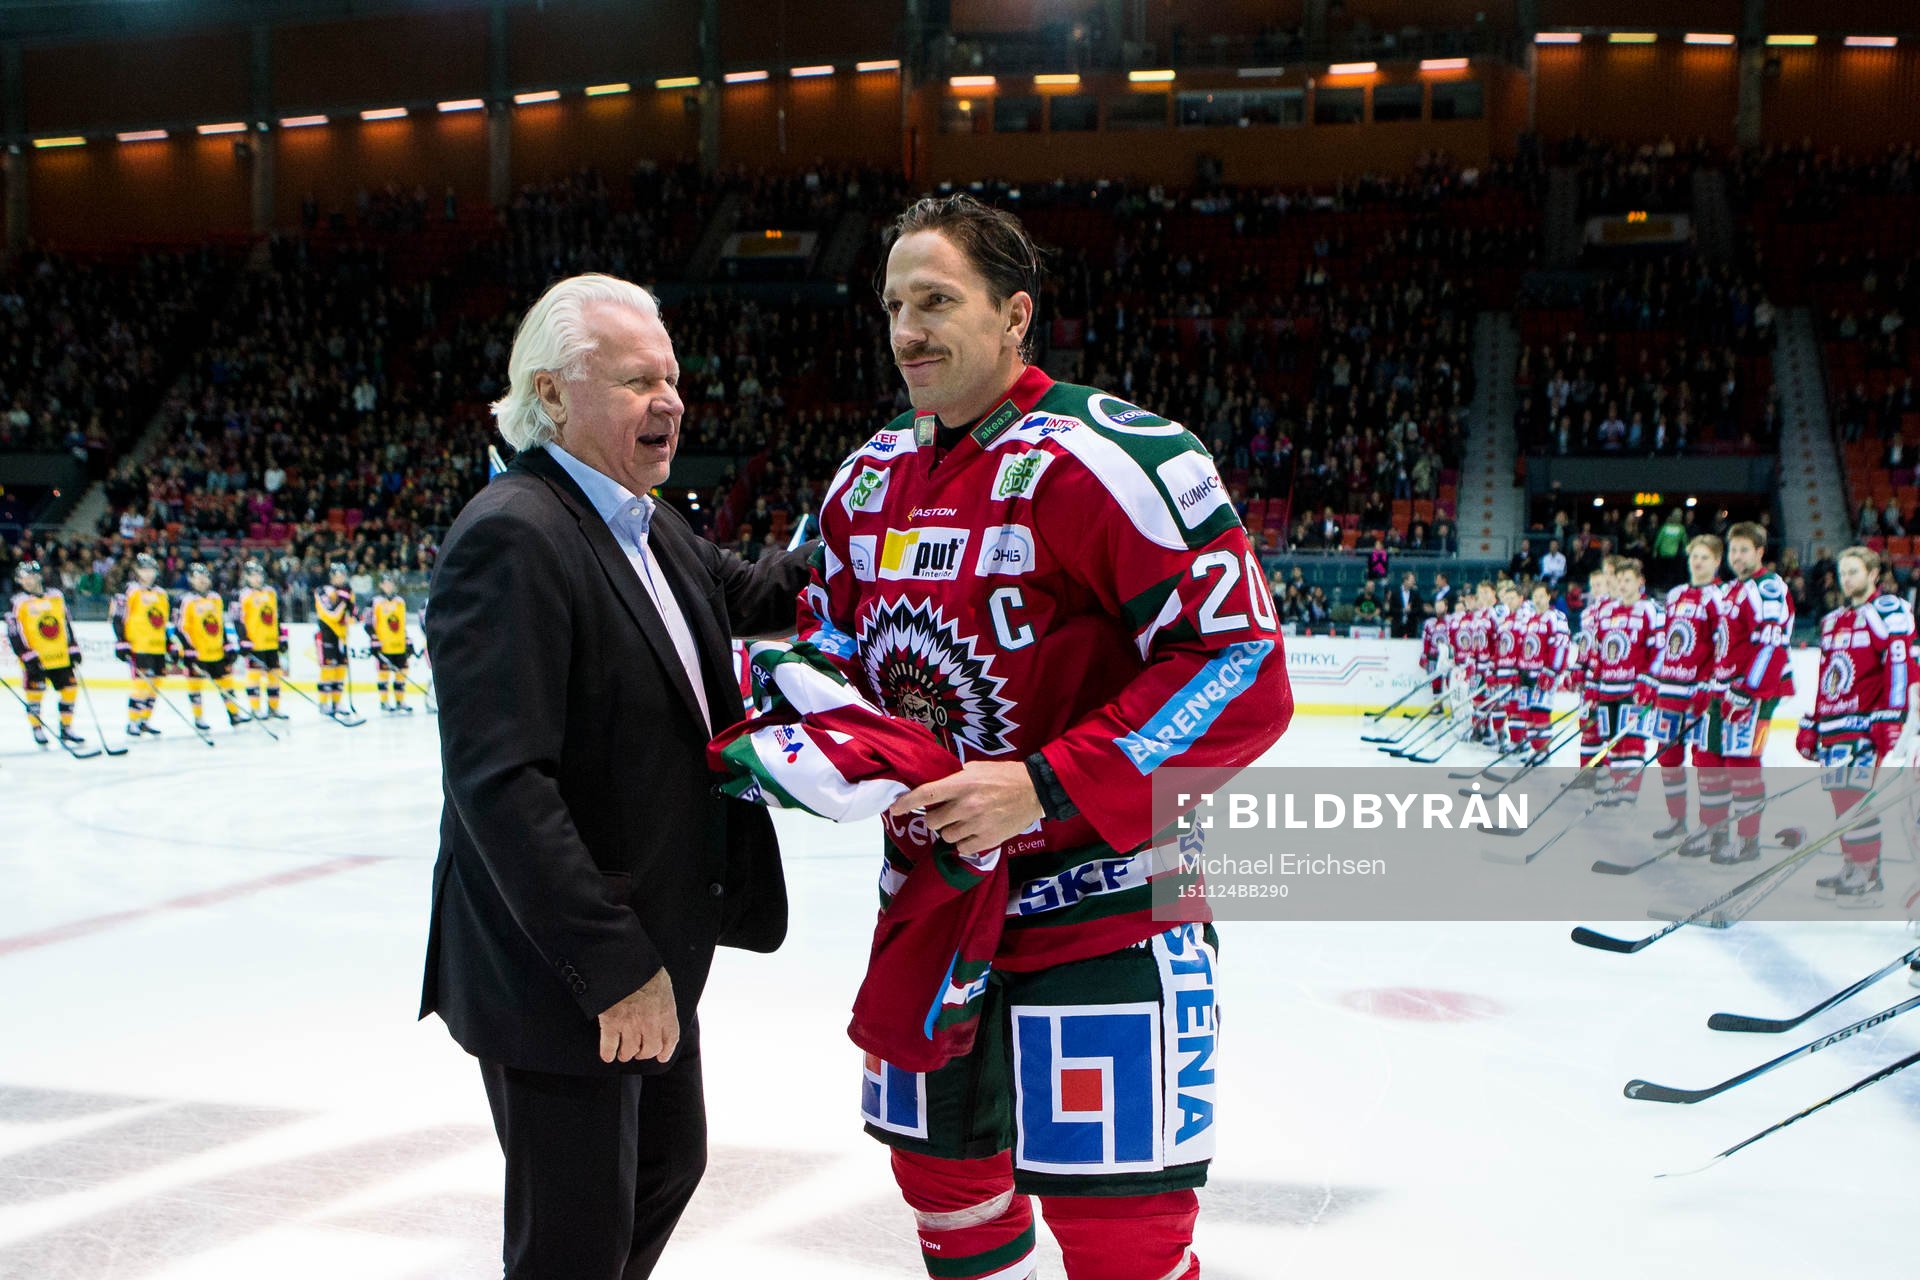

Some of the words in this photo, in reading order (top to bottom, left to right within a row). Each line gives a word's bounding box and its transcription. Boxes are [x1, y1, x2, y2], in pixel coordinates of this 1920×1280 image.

[981, 416, 1005, 439] akea
[909, 507, 957, 521] EASTON
[1178, 476, 1218, 511] KUMHO
[912, 538, 959, 576] put
[1190, 549, 1277, 633] 20
[988, 586, 1036, 651] C
[1007, 845, 1016, 855] &
[1018, 838, 1046, 852] Event
[1019, 857, 1135, 915] SKF
[1161, 923, 1215, 1147] STENA
[1809, 1009, 1897, 1054] EASTON
